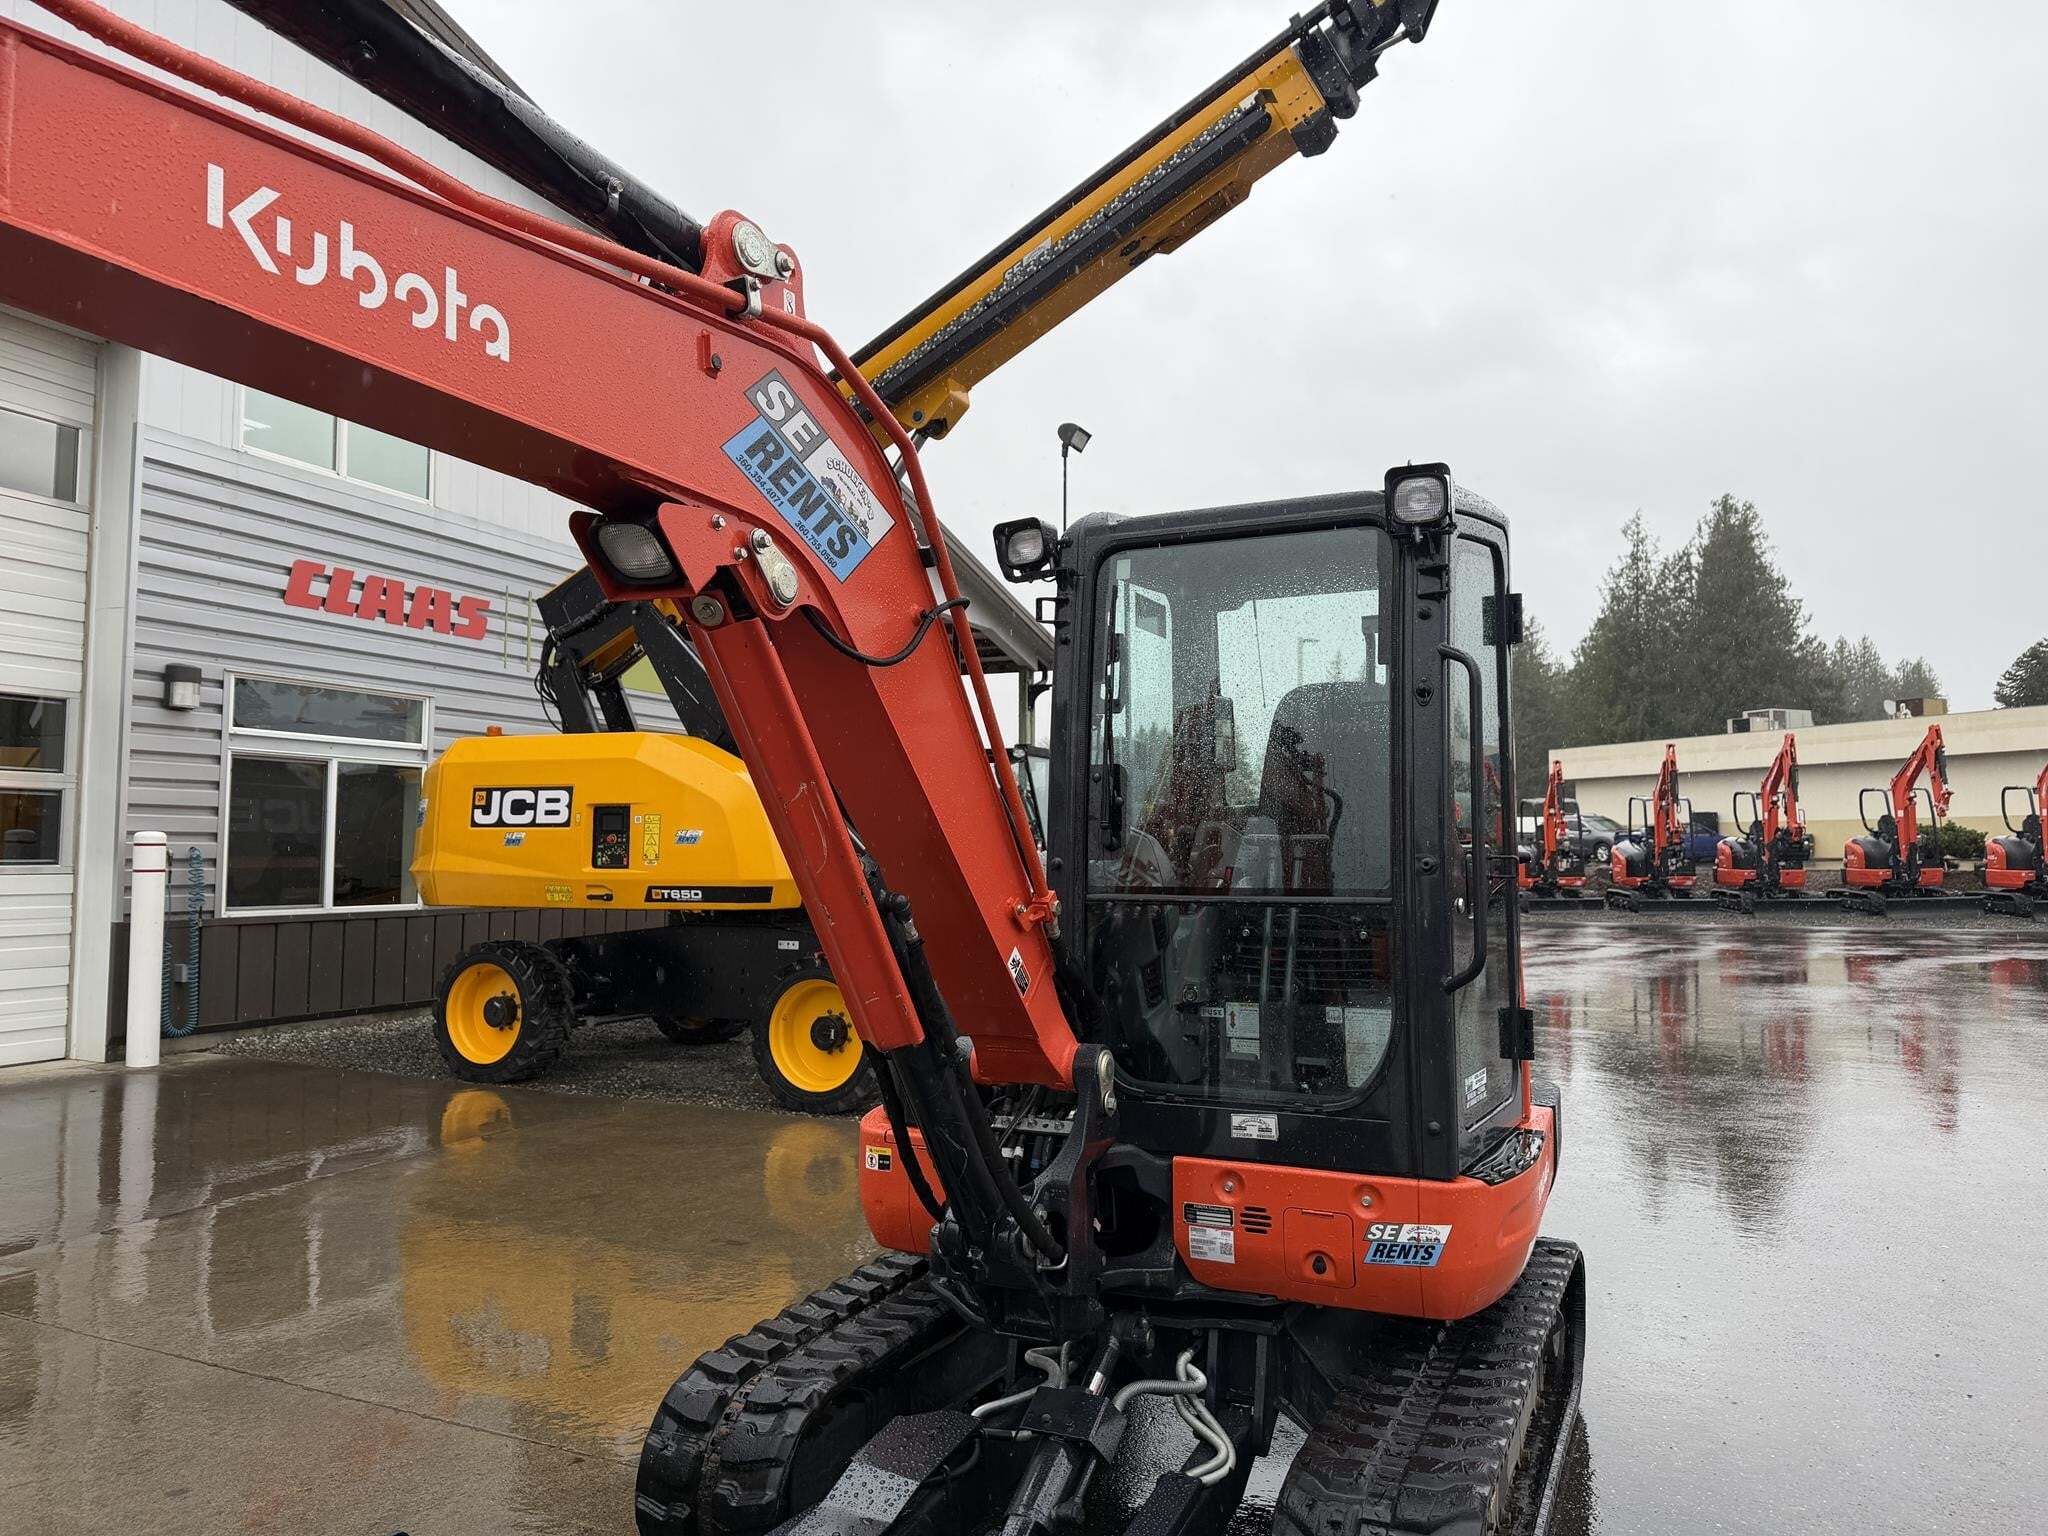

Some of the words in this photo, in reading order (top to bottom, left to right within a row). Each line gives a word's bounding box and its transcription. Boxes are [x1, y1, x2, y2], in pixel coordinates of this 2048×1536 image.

[207, 162, 511, 363] Kubota
[756, 380, 820, 453] SE
[735, 454, 784, 508] 360.354.4071
[744, 430, 858, 560] RENTS
[283, 559, 491, 641] CLAAS
[473, 790, 570, 824] JCB
[1367, 1224, 1399, 1240] SE
[1372, 1243, 1436, 1260] RENTS
